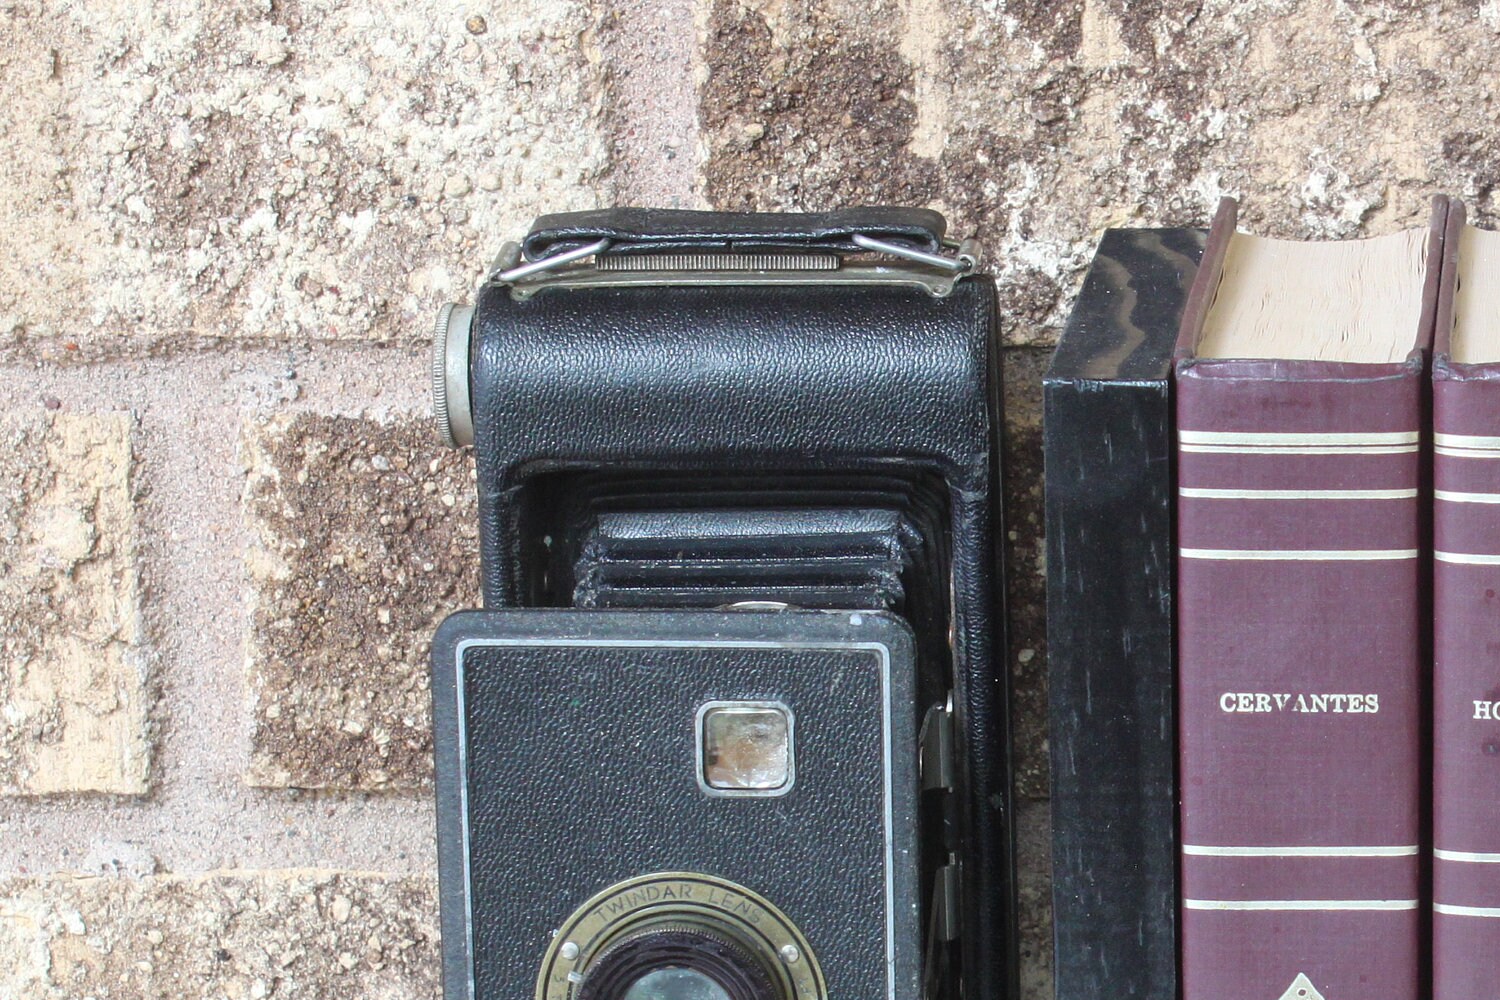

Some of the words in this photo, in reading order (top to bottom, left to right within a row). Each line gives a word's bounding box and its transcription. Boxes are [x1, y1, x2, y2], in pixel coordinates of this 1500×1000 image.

[1219, 692, 1380, 714] CERVANTES
[592, 883, 692, 922] TWINDAR
[709, 887, 766, 924] LENS
